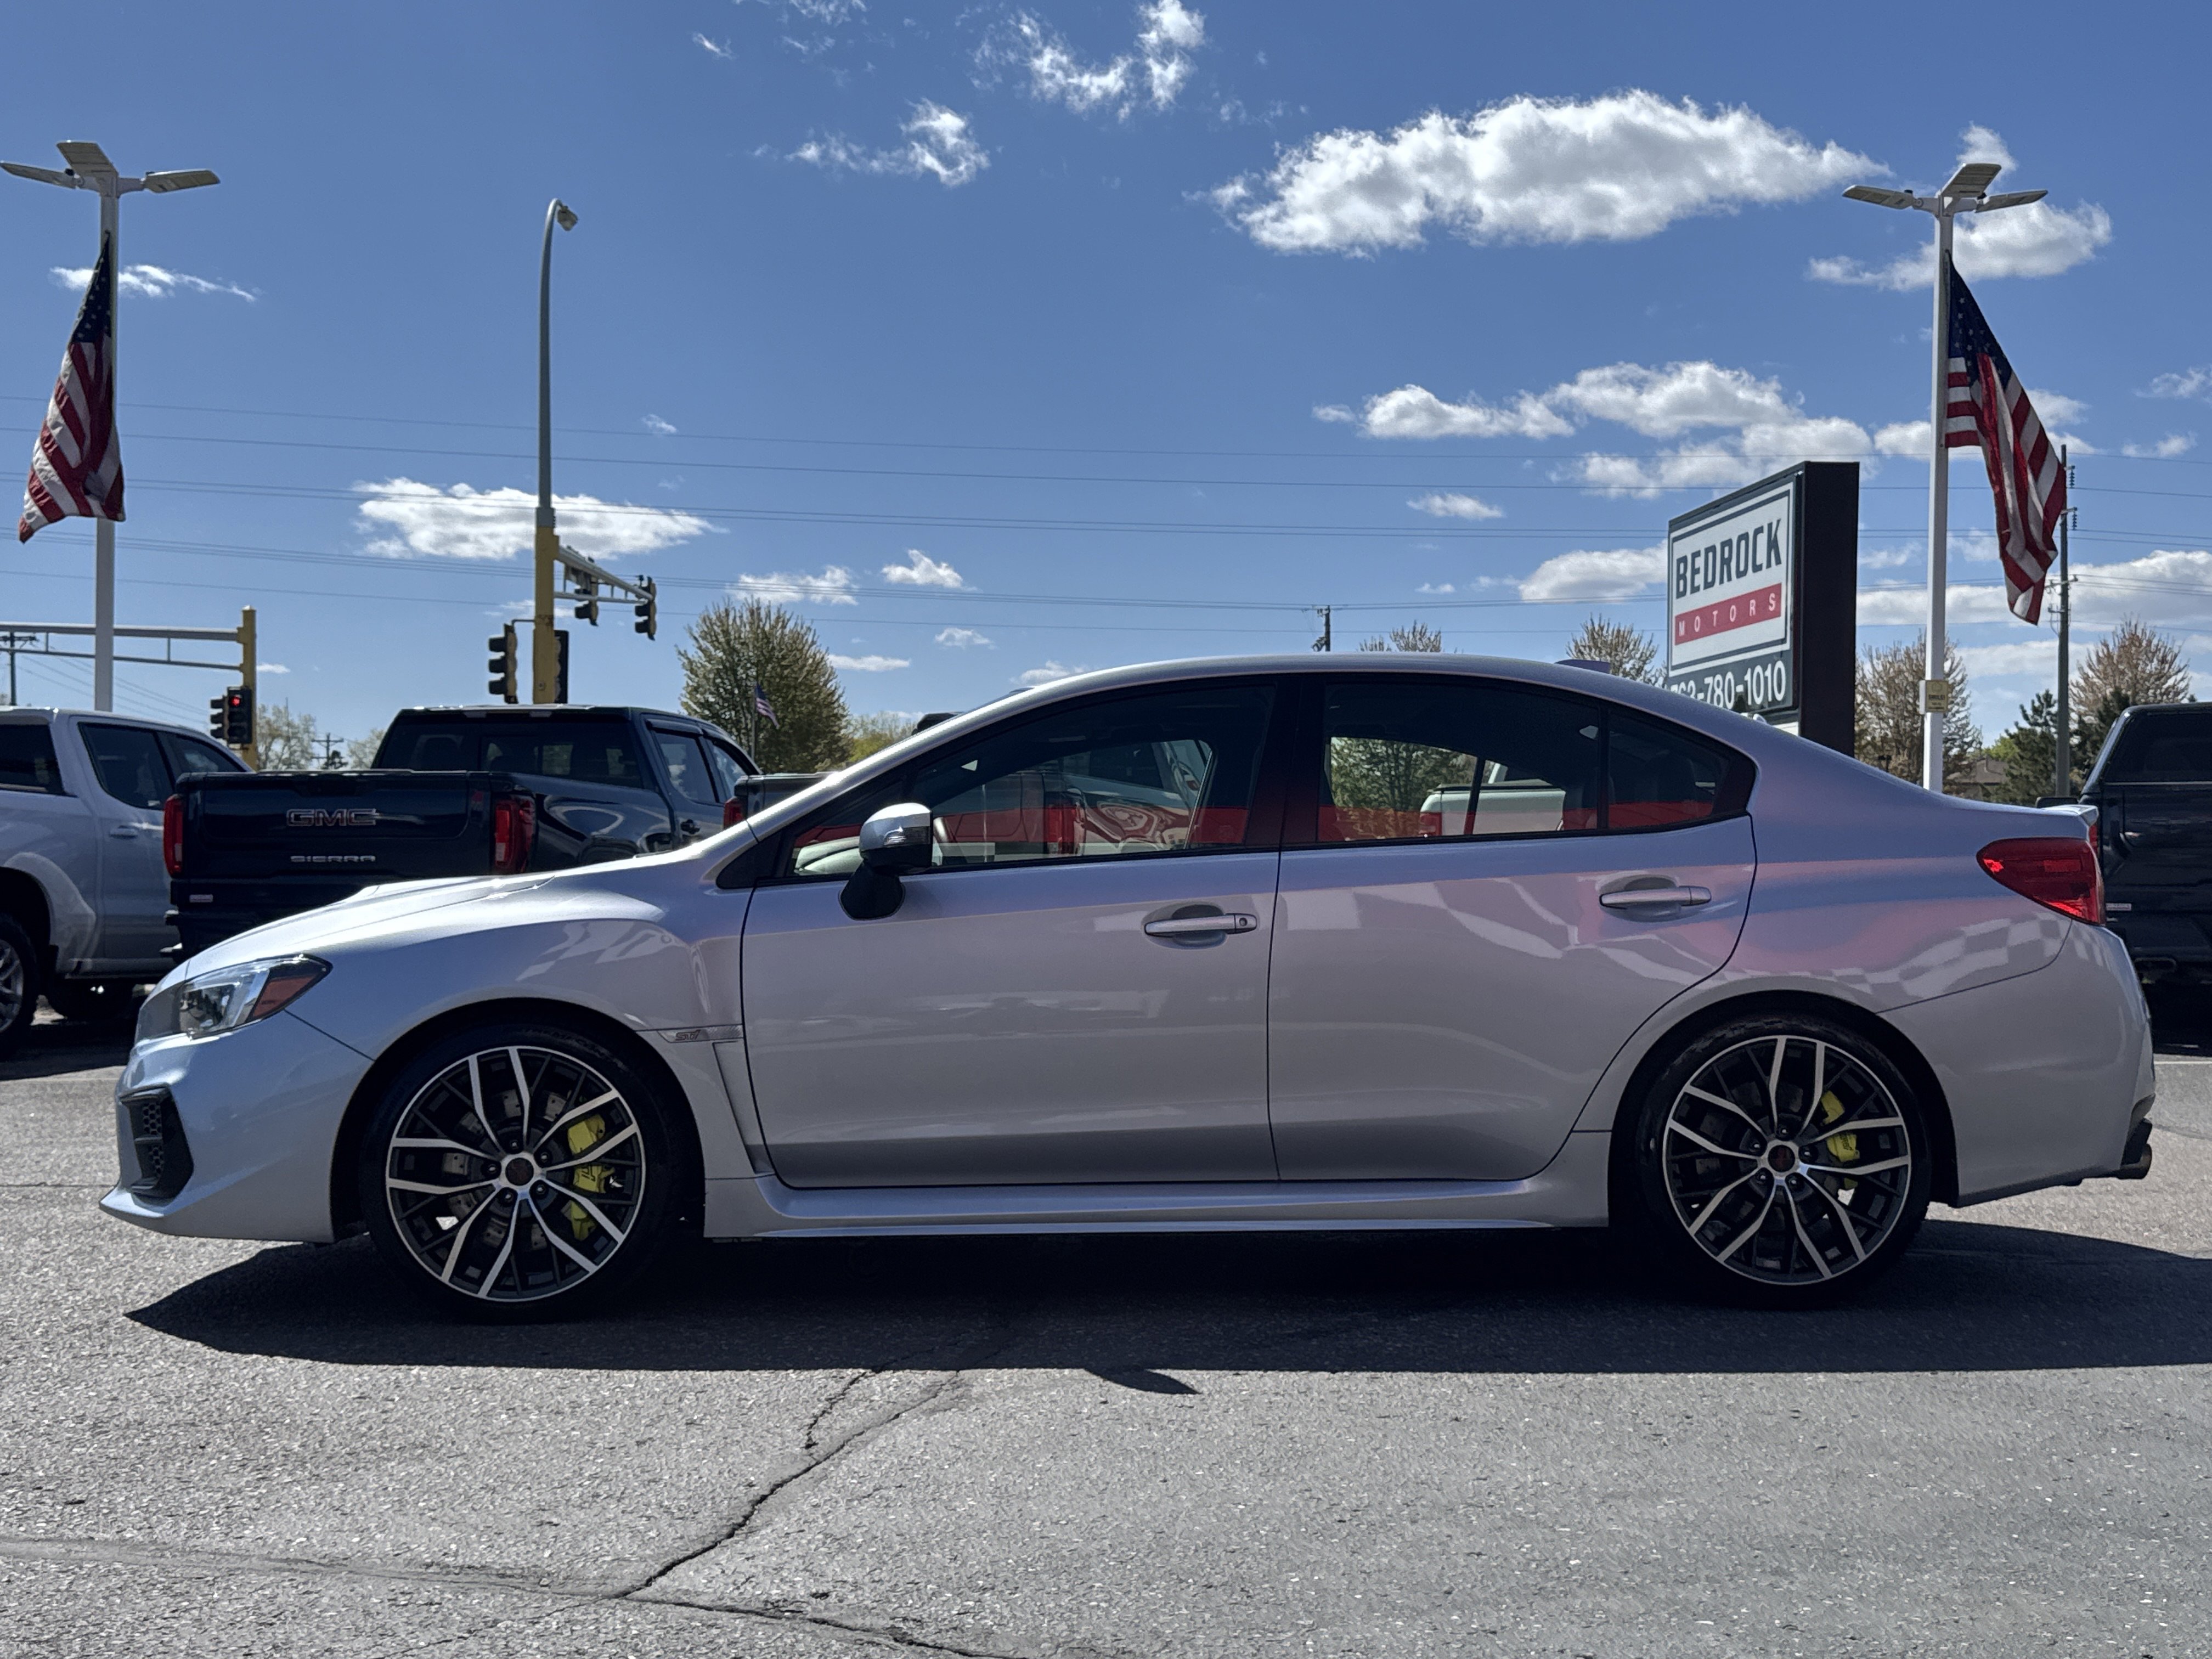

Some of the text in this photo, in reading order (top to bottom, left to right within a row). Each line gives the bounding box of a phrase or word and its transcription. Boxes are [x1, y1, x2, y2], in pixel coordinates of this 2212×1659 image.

[1676, 518, 1782, 599] BEDROCK
[1679, 592, 1776, 636] MOTORS
[287, 808, 376, 827] GMC
